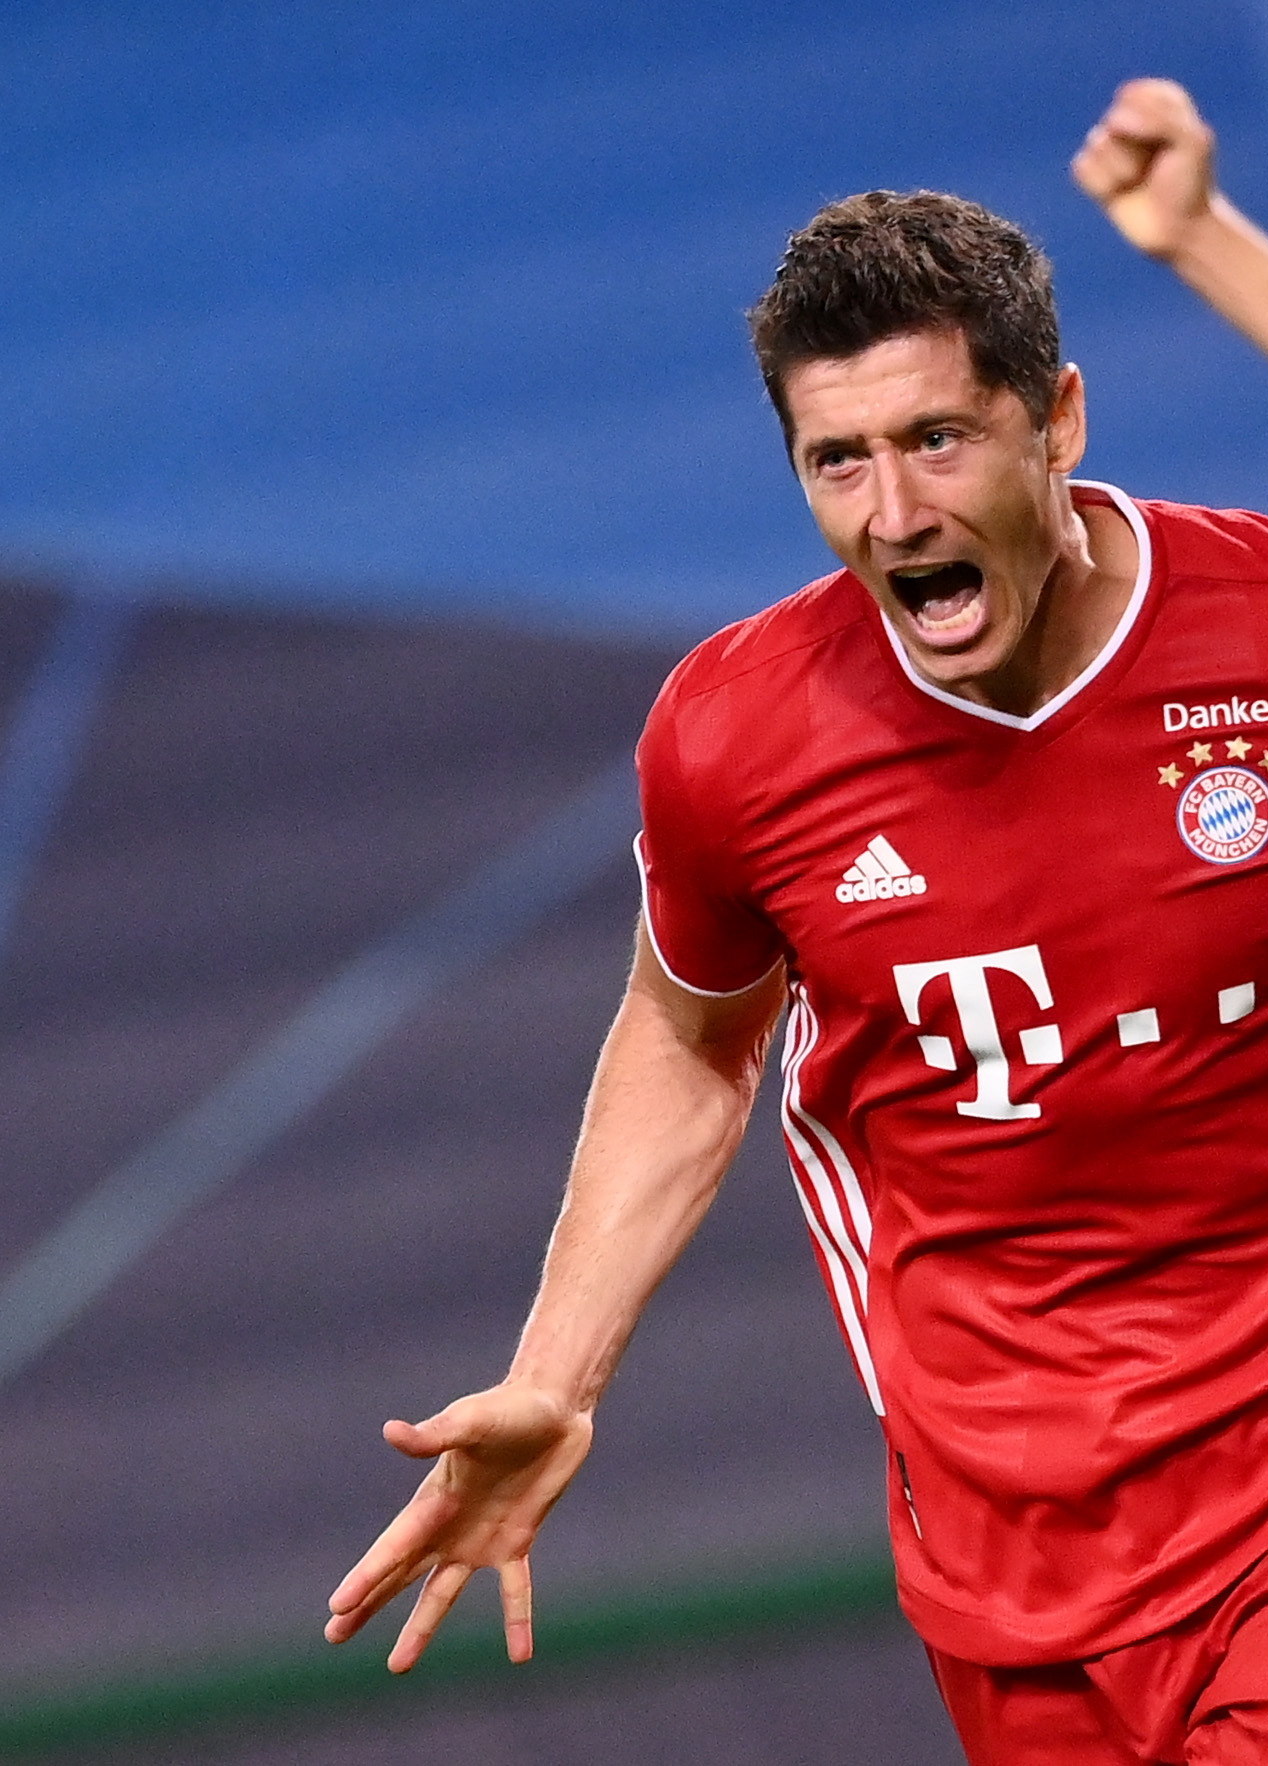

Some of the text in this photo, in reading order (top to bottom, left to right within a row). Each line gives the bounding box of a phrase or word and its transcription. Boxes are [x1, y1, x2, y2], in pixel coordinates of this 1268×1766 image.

[1185, 773, 1266, 814] FC BAYERN
[835, 874, 927, 904] adidas
